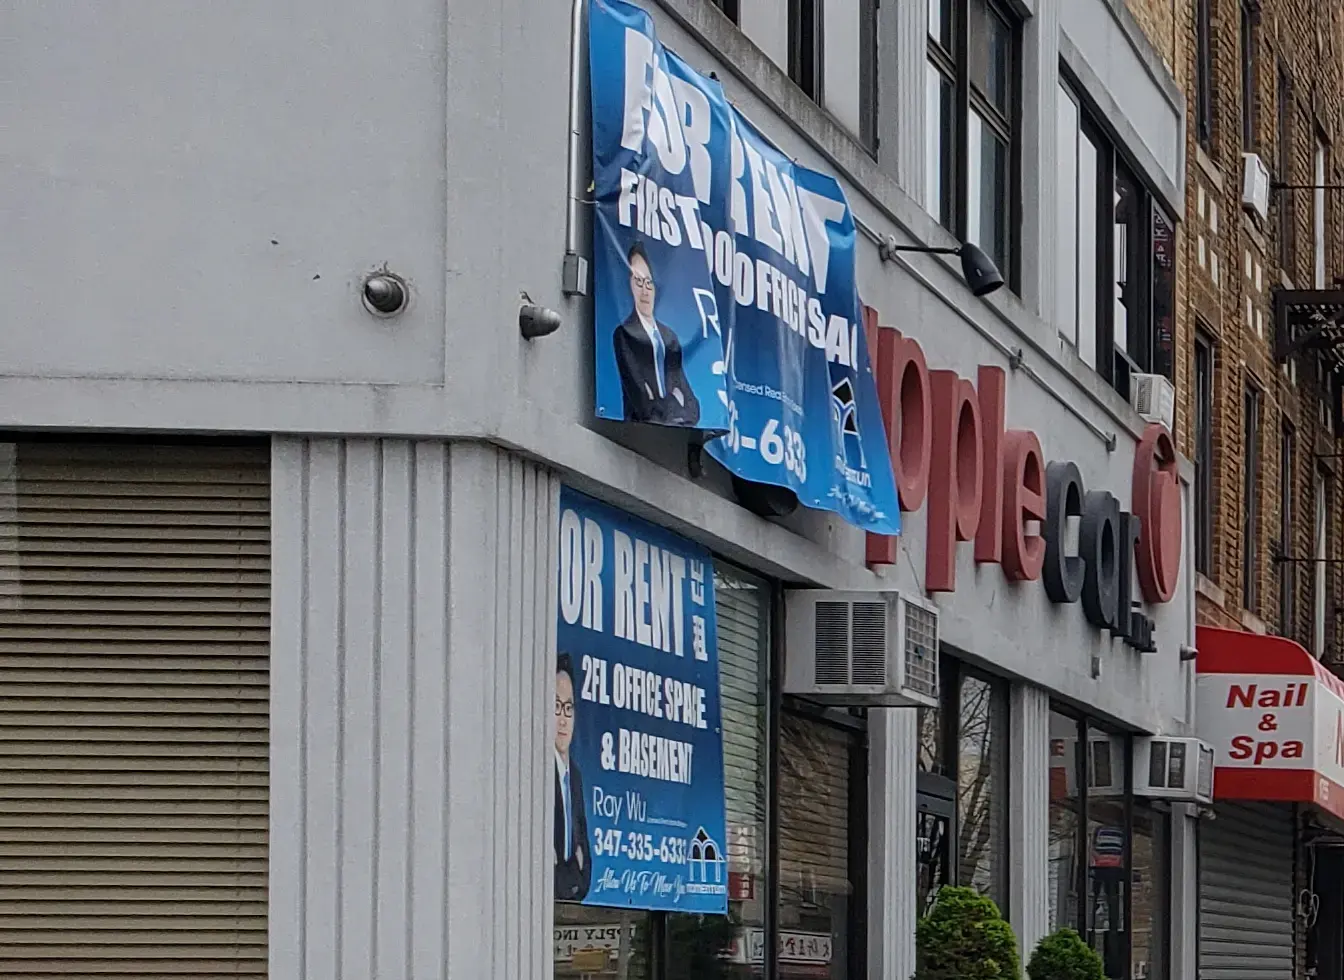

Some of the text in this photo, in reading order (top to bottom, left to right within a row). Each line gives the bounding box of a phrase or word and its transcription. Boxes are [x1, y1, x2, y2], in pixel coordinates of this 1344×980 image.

[621, 27, 845, 294] FOR RENT
[619, 167, 704, 250] FIRST
[560, 508, 686, 657] OR RENT
[581, 654, 610, 705] 2FL
[613, 663, 663, 718] OFFICE
[1226, 683, 1308, 708] Nail
[1258, 714, 1278, 731] &
[601, 732, 615, 770] &
[1229, 736, 1304, 765] Spa
[592, 786, 647, 825] Ray Wu
